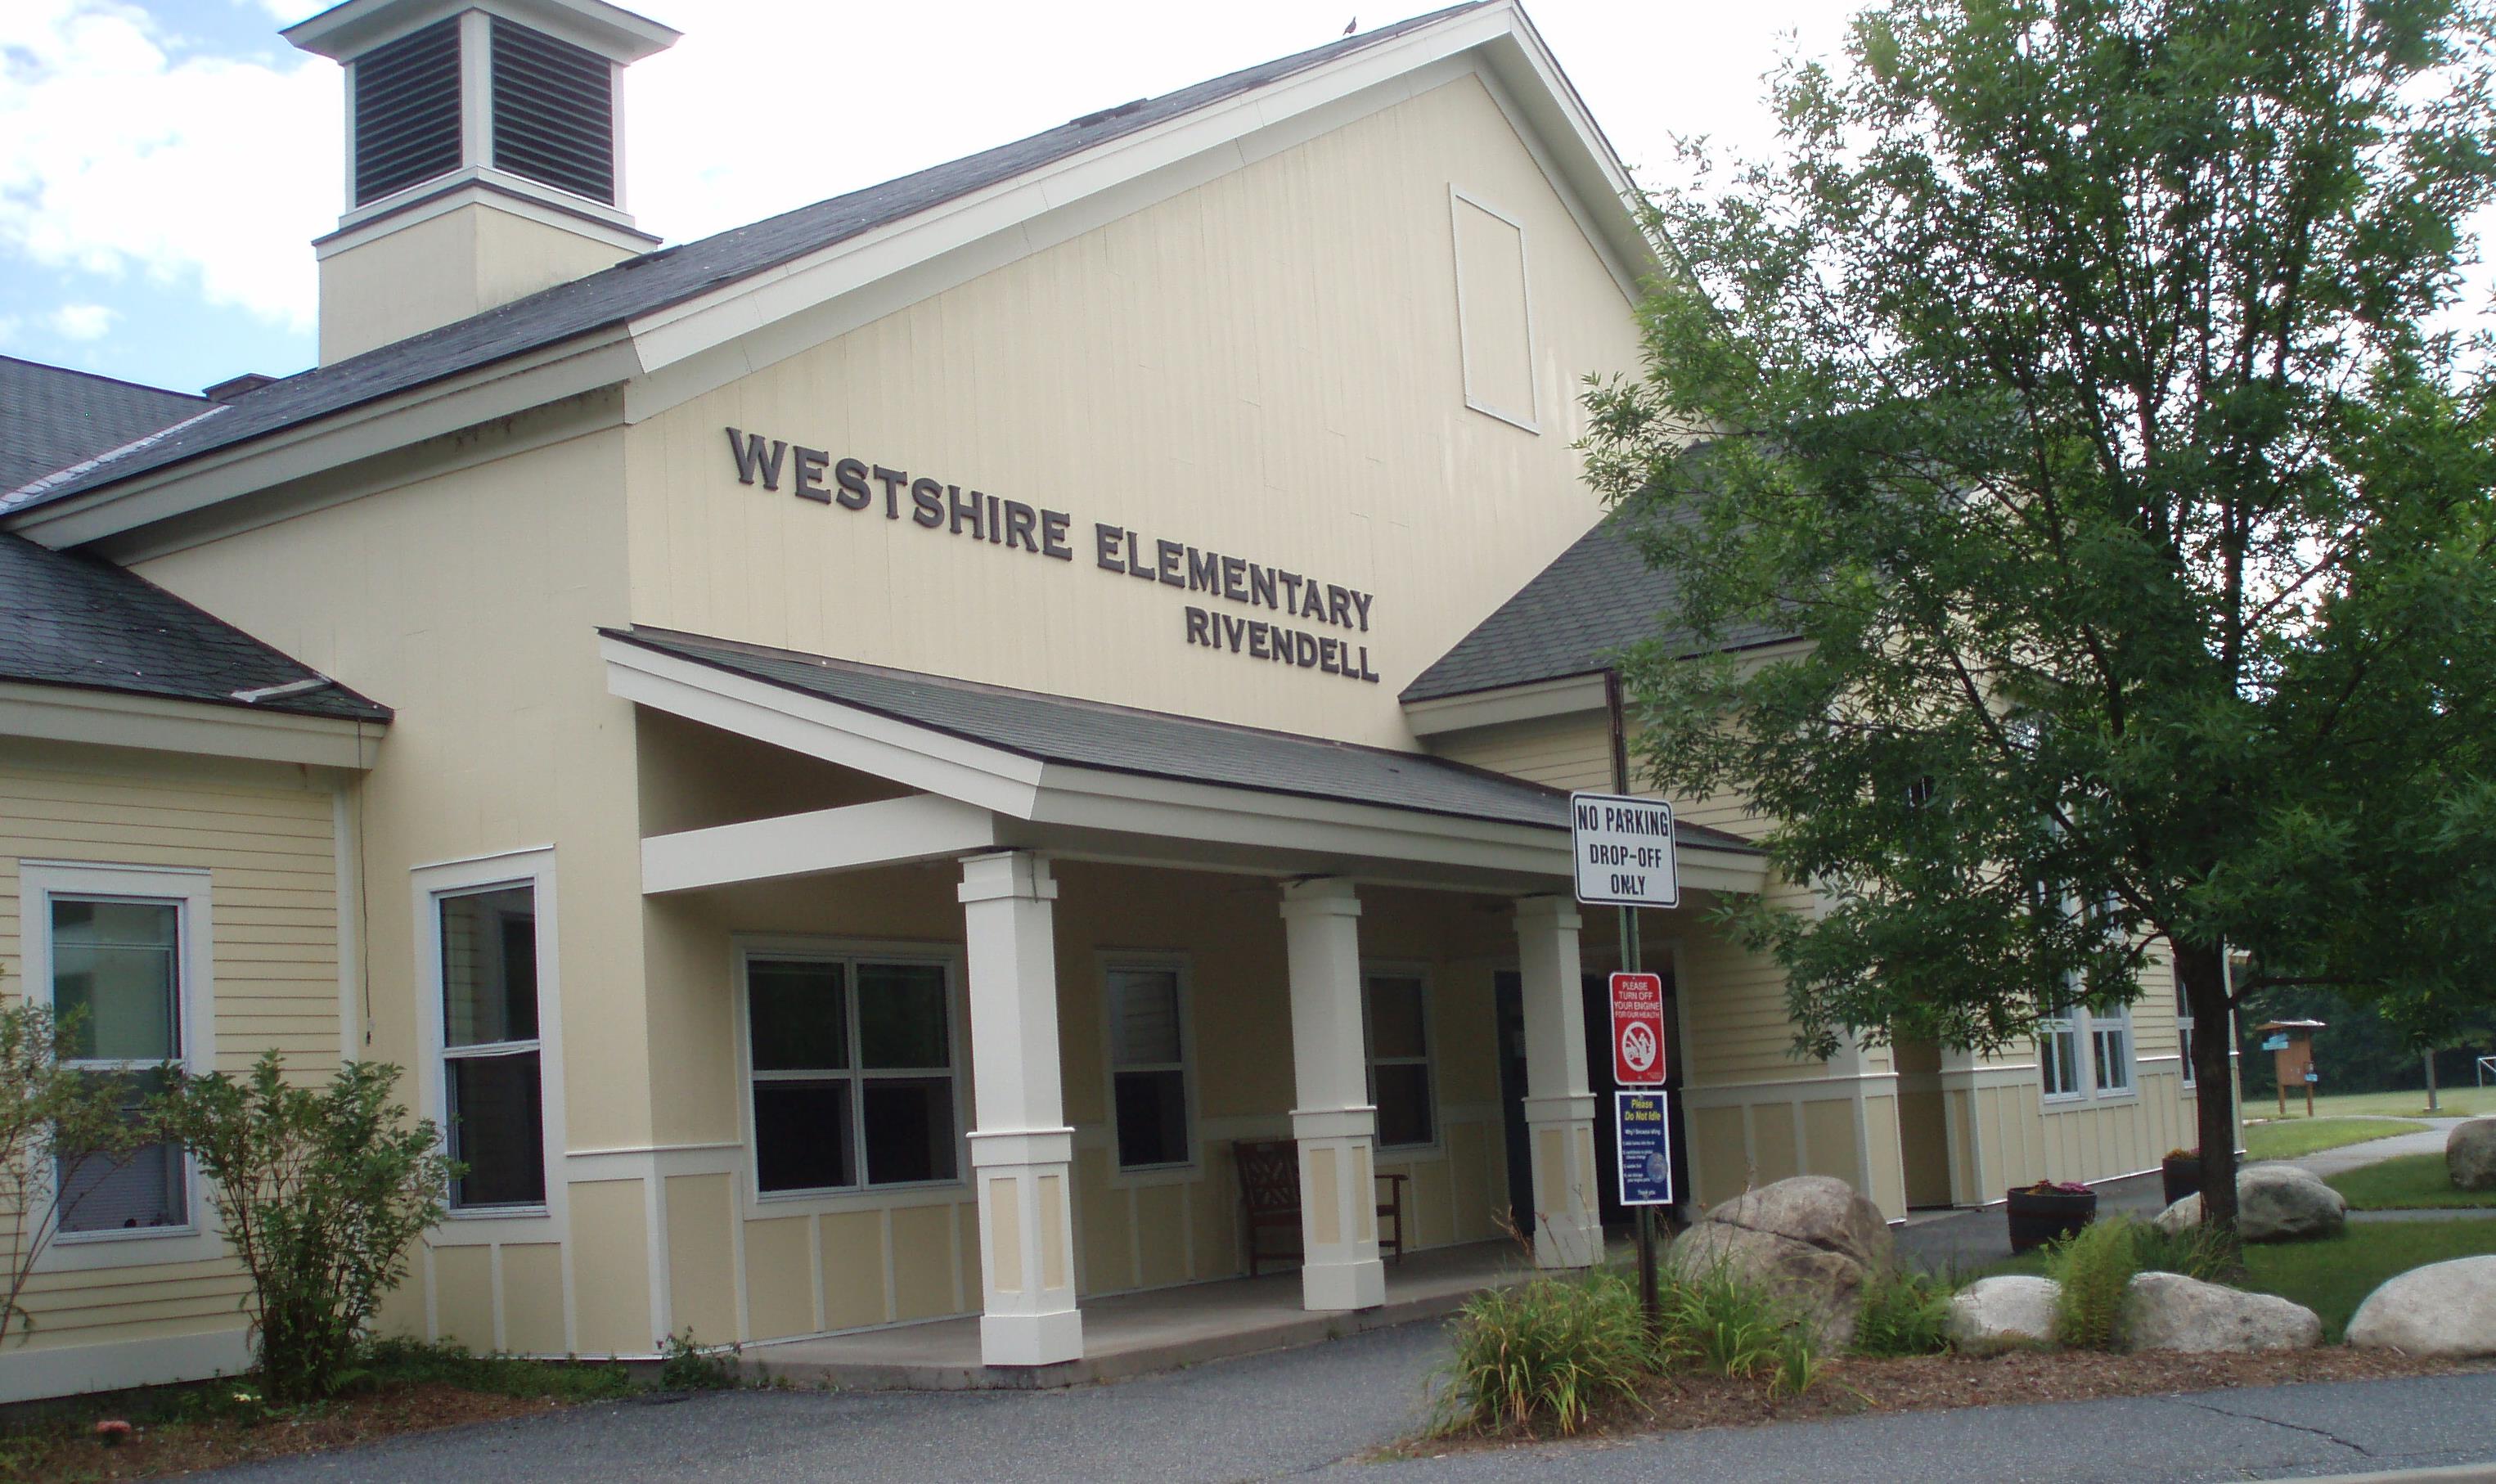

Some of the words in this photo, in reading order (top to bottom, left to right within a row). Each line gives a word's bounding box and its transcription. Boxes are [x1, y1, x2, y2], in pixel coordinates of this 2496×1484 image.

[726, 426, 1073, 561] WESTSHIRE
[1095, 522, 1374, 632] ELEMENTARY
[1185, 605, 1380, 683] RIVENDELL
[1577, 804, 1599, 831] NO
[1606, 807, 1669, 837] PARKING
[1590, 843, 1662, 868] DROP-OFF
[1611, 874, 1645, 896] ONLY
[1622, 982, 1648, 991] PLEASE
[1618, 991, 1638, 1000] TURN
[1638, 992, 1653, 1001] OFF
[1614, 1001, 1633, 1010] YOUR
[1634, 1001, 1661, 1011] ENGINE
[1615, 1010, 1626, 1019] FOR
[1626, 1010, 1639, 1019] OUR
[1639, 1011, 1660, 1019] HEALTH
[1631, 1099, 1653, 1109] Please
[1625, 1111, 1635, 1121] Do
[1635, 1111, 1648, 1121] Not
[1648, 1111, 1662, 1121] Idle
